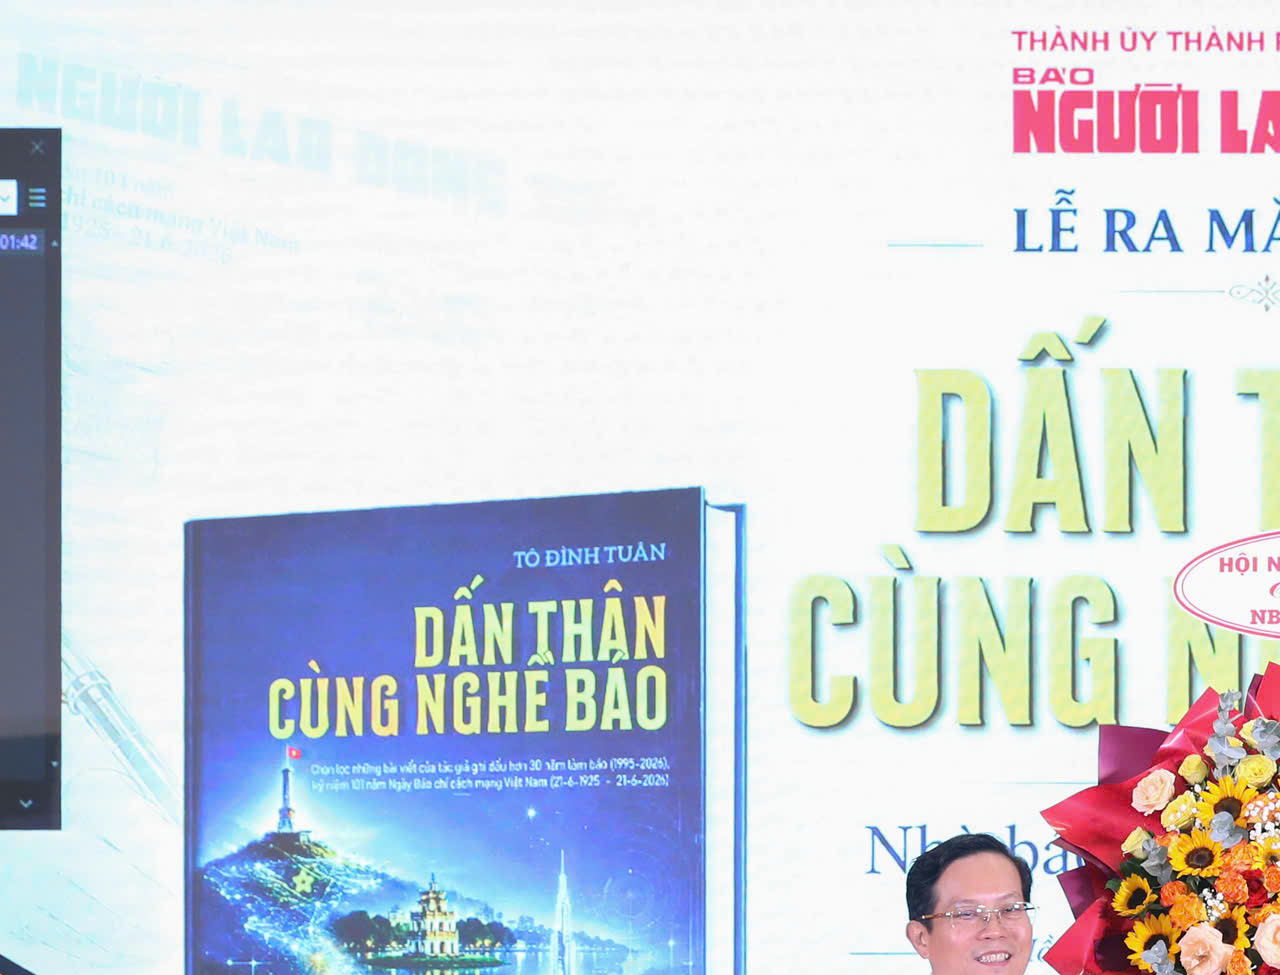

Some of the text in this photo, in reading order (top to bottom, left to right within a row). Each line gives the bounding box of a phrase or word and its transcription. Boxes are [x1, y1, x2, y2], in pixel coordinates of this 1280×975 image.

[1010, 25, 1110, 52] THÀNH
[1166, 25, 1265, 52] THÀNH
[1012, 67, 1095, 85] BÁO
[1012, 83, 1200, 155] NGƯỜI
[1013, 187, 1079, 253] LỄ
[1103, 207, 1185, 253] RA
[914, 316, 1190, 533] DẤN
[545, 546, 600, 567] ĐÌNH
[603, 541, 666, 564] TUÂN
[1218, 552, 1258, 576] HỘI
[413, 573, 667, 668] DẤN THÂN
[790, 544, 1120, 728] CÙNG
[1250, 608, 1280, 625] NB
[267, 647, 668, 740] CÙNG NGHỀ BÁO
[529, 759, 541, 771] 30
